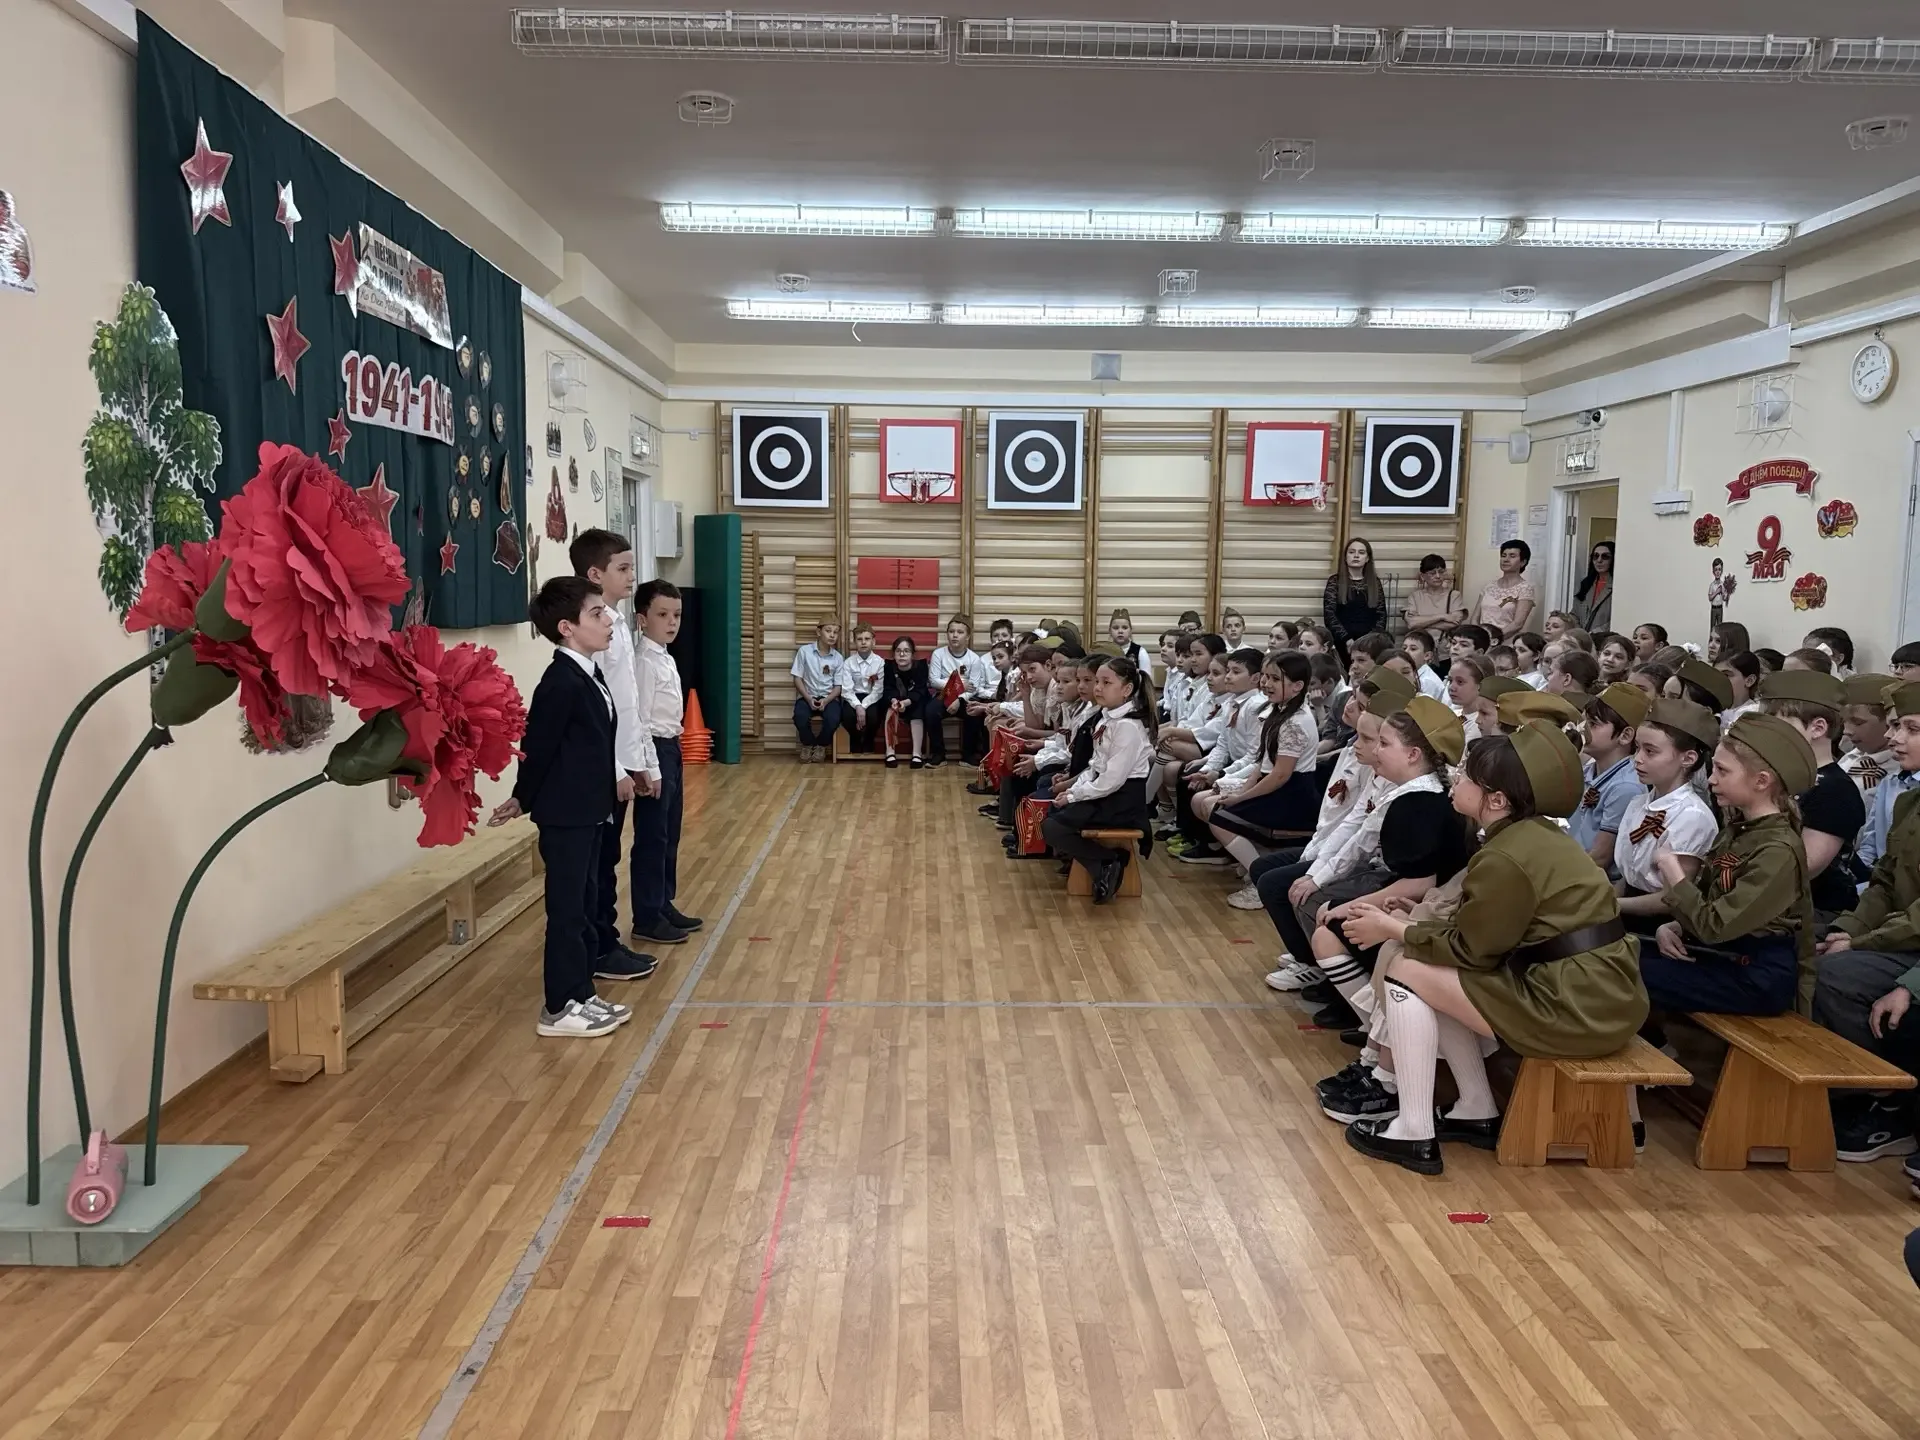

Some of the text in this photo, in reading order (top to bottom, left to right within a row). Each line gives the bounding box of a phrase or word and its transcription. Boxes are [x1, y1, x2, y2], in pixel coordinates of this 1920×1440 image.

[1742, 475, 1749, 486] С
[1757, 515, 1781, 564] 9
[1751, 559, 1785, 580] МАЯ
